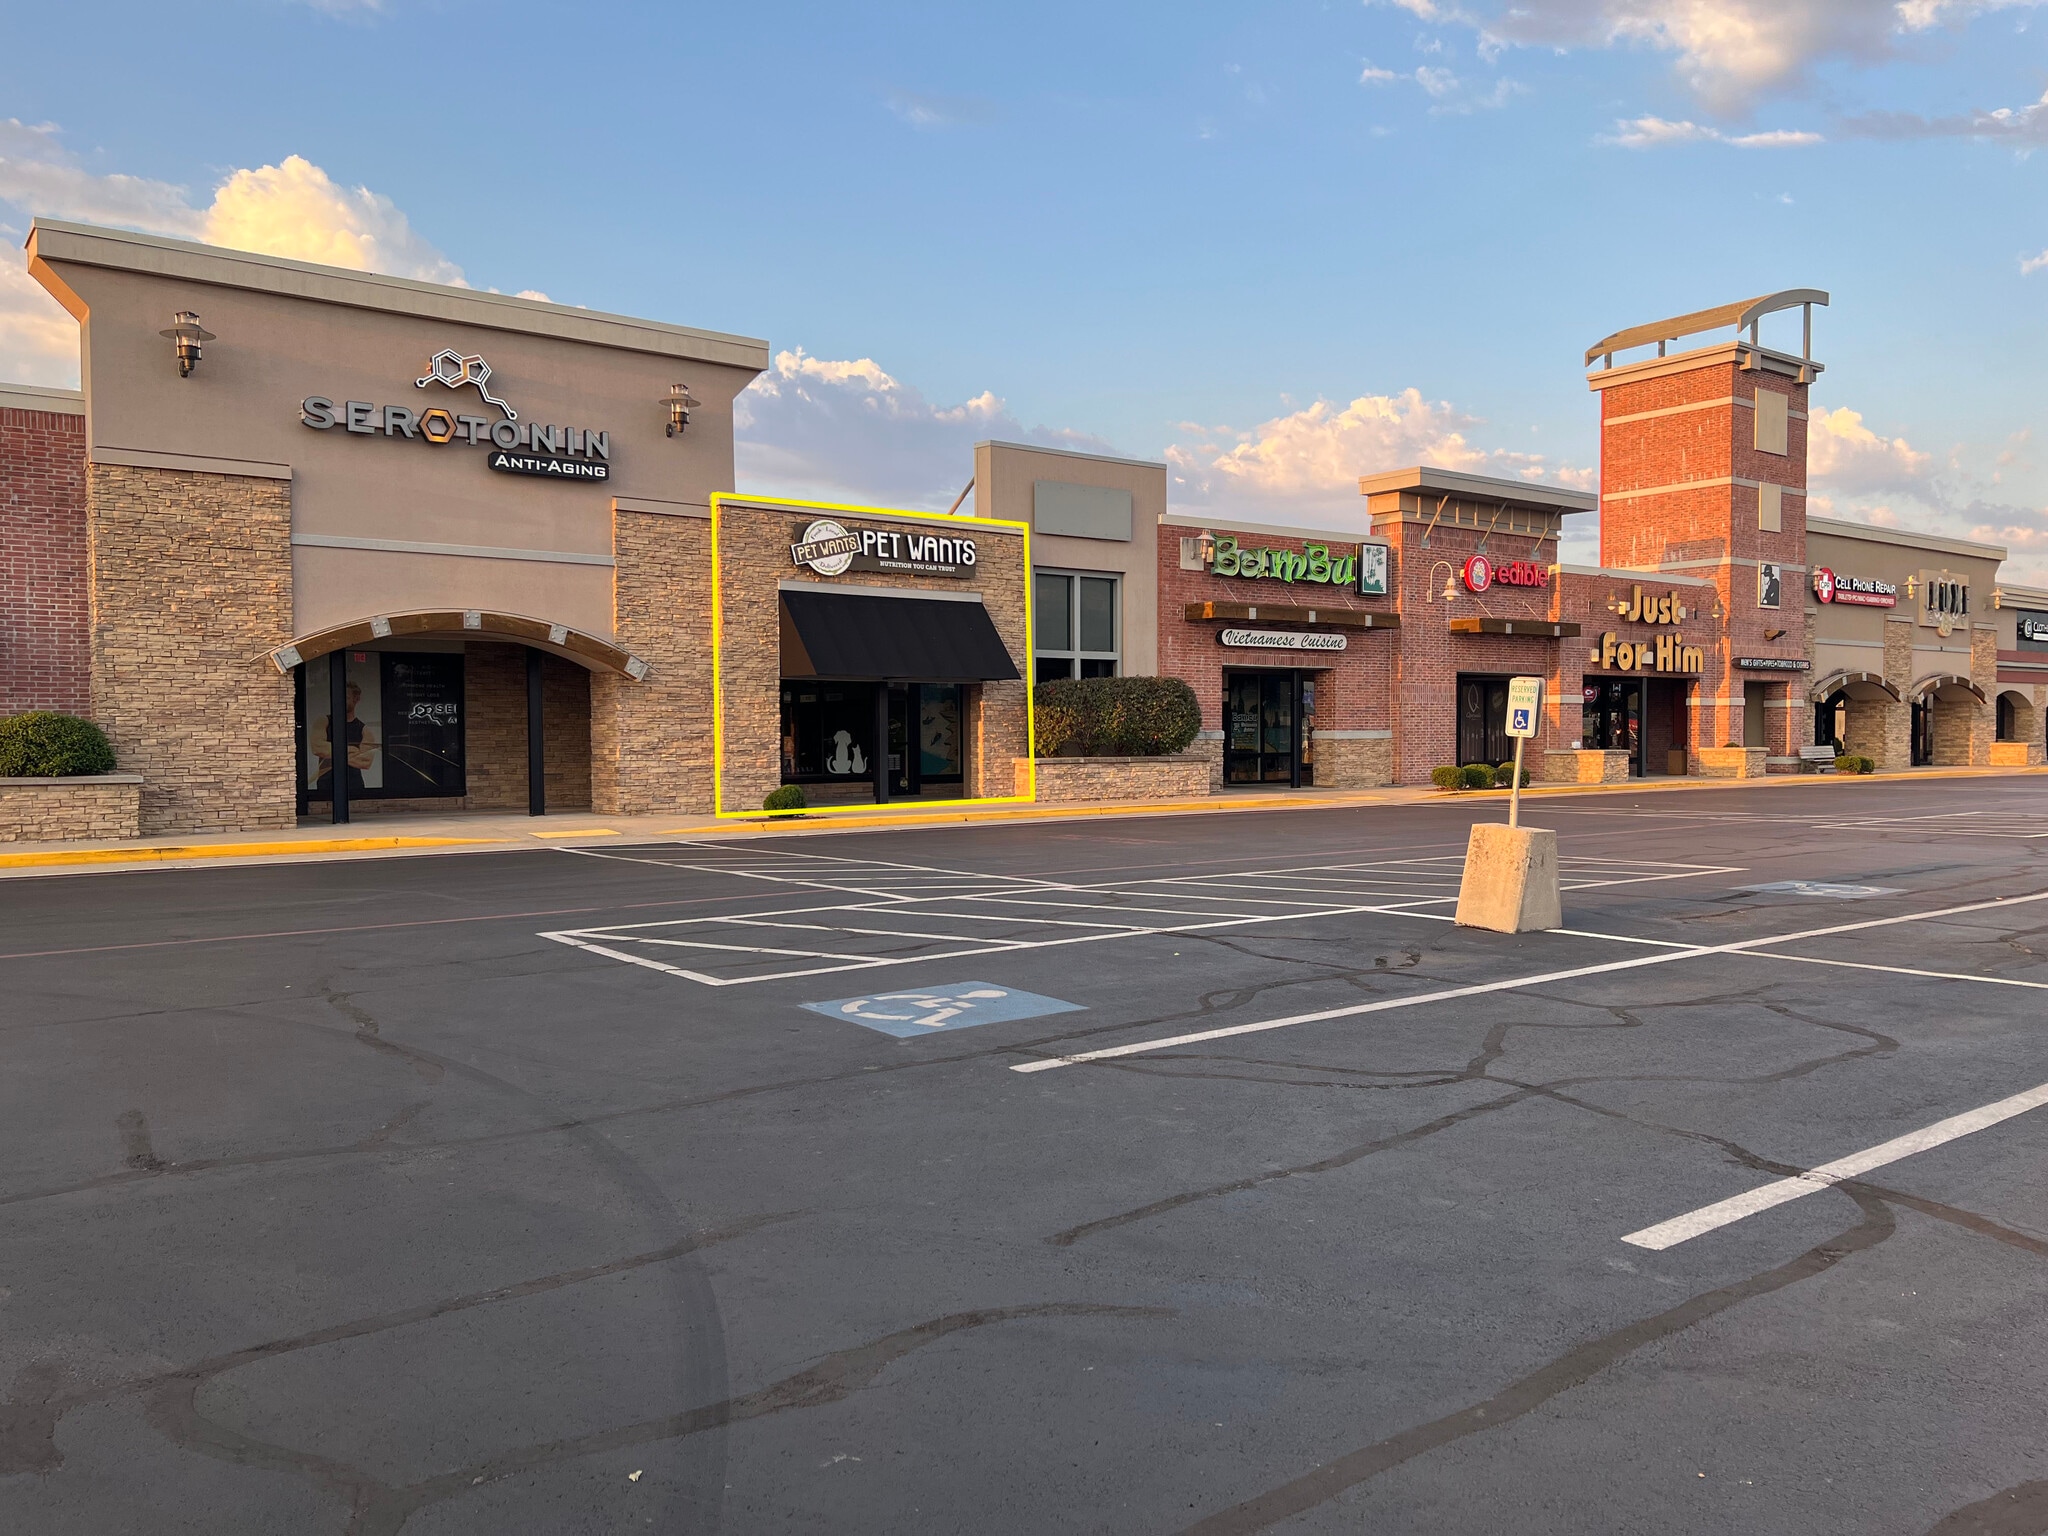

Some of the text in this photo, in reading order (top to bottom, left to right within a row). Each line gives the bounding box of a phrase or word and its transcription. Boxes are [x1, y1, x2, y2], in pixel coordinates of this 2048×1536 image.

[302, 396, 609, 460] SEROTONIN
[494, 454, 607, 478] ANTI-AGING
[797, 537, 857, 561] PET WANTS
[862, 530, 977, 566] PET WANTS
[880, 560, 912, 569] NUTRITION
[1497, 561, 1549, 587] edible
[1625, 584, 1682, 625] Just
[1225, 629, 1344, 649] Vietnamese Cuisine
[1655, 631, 1704, 673] Him
[1511, 685, 1538, 693] RESERVED
[1511, 694, 1535, 704] PARKING
